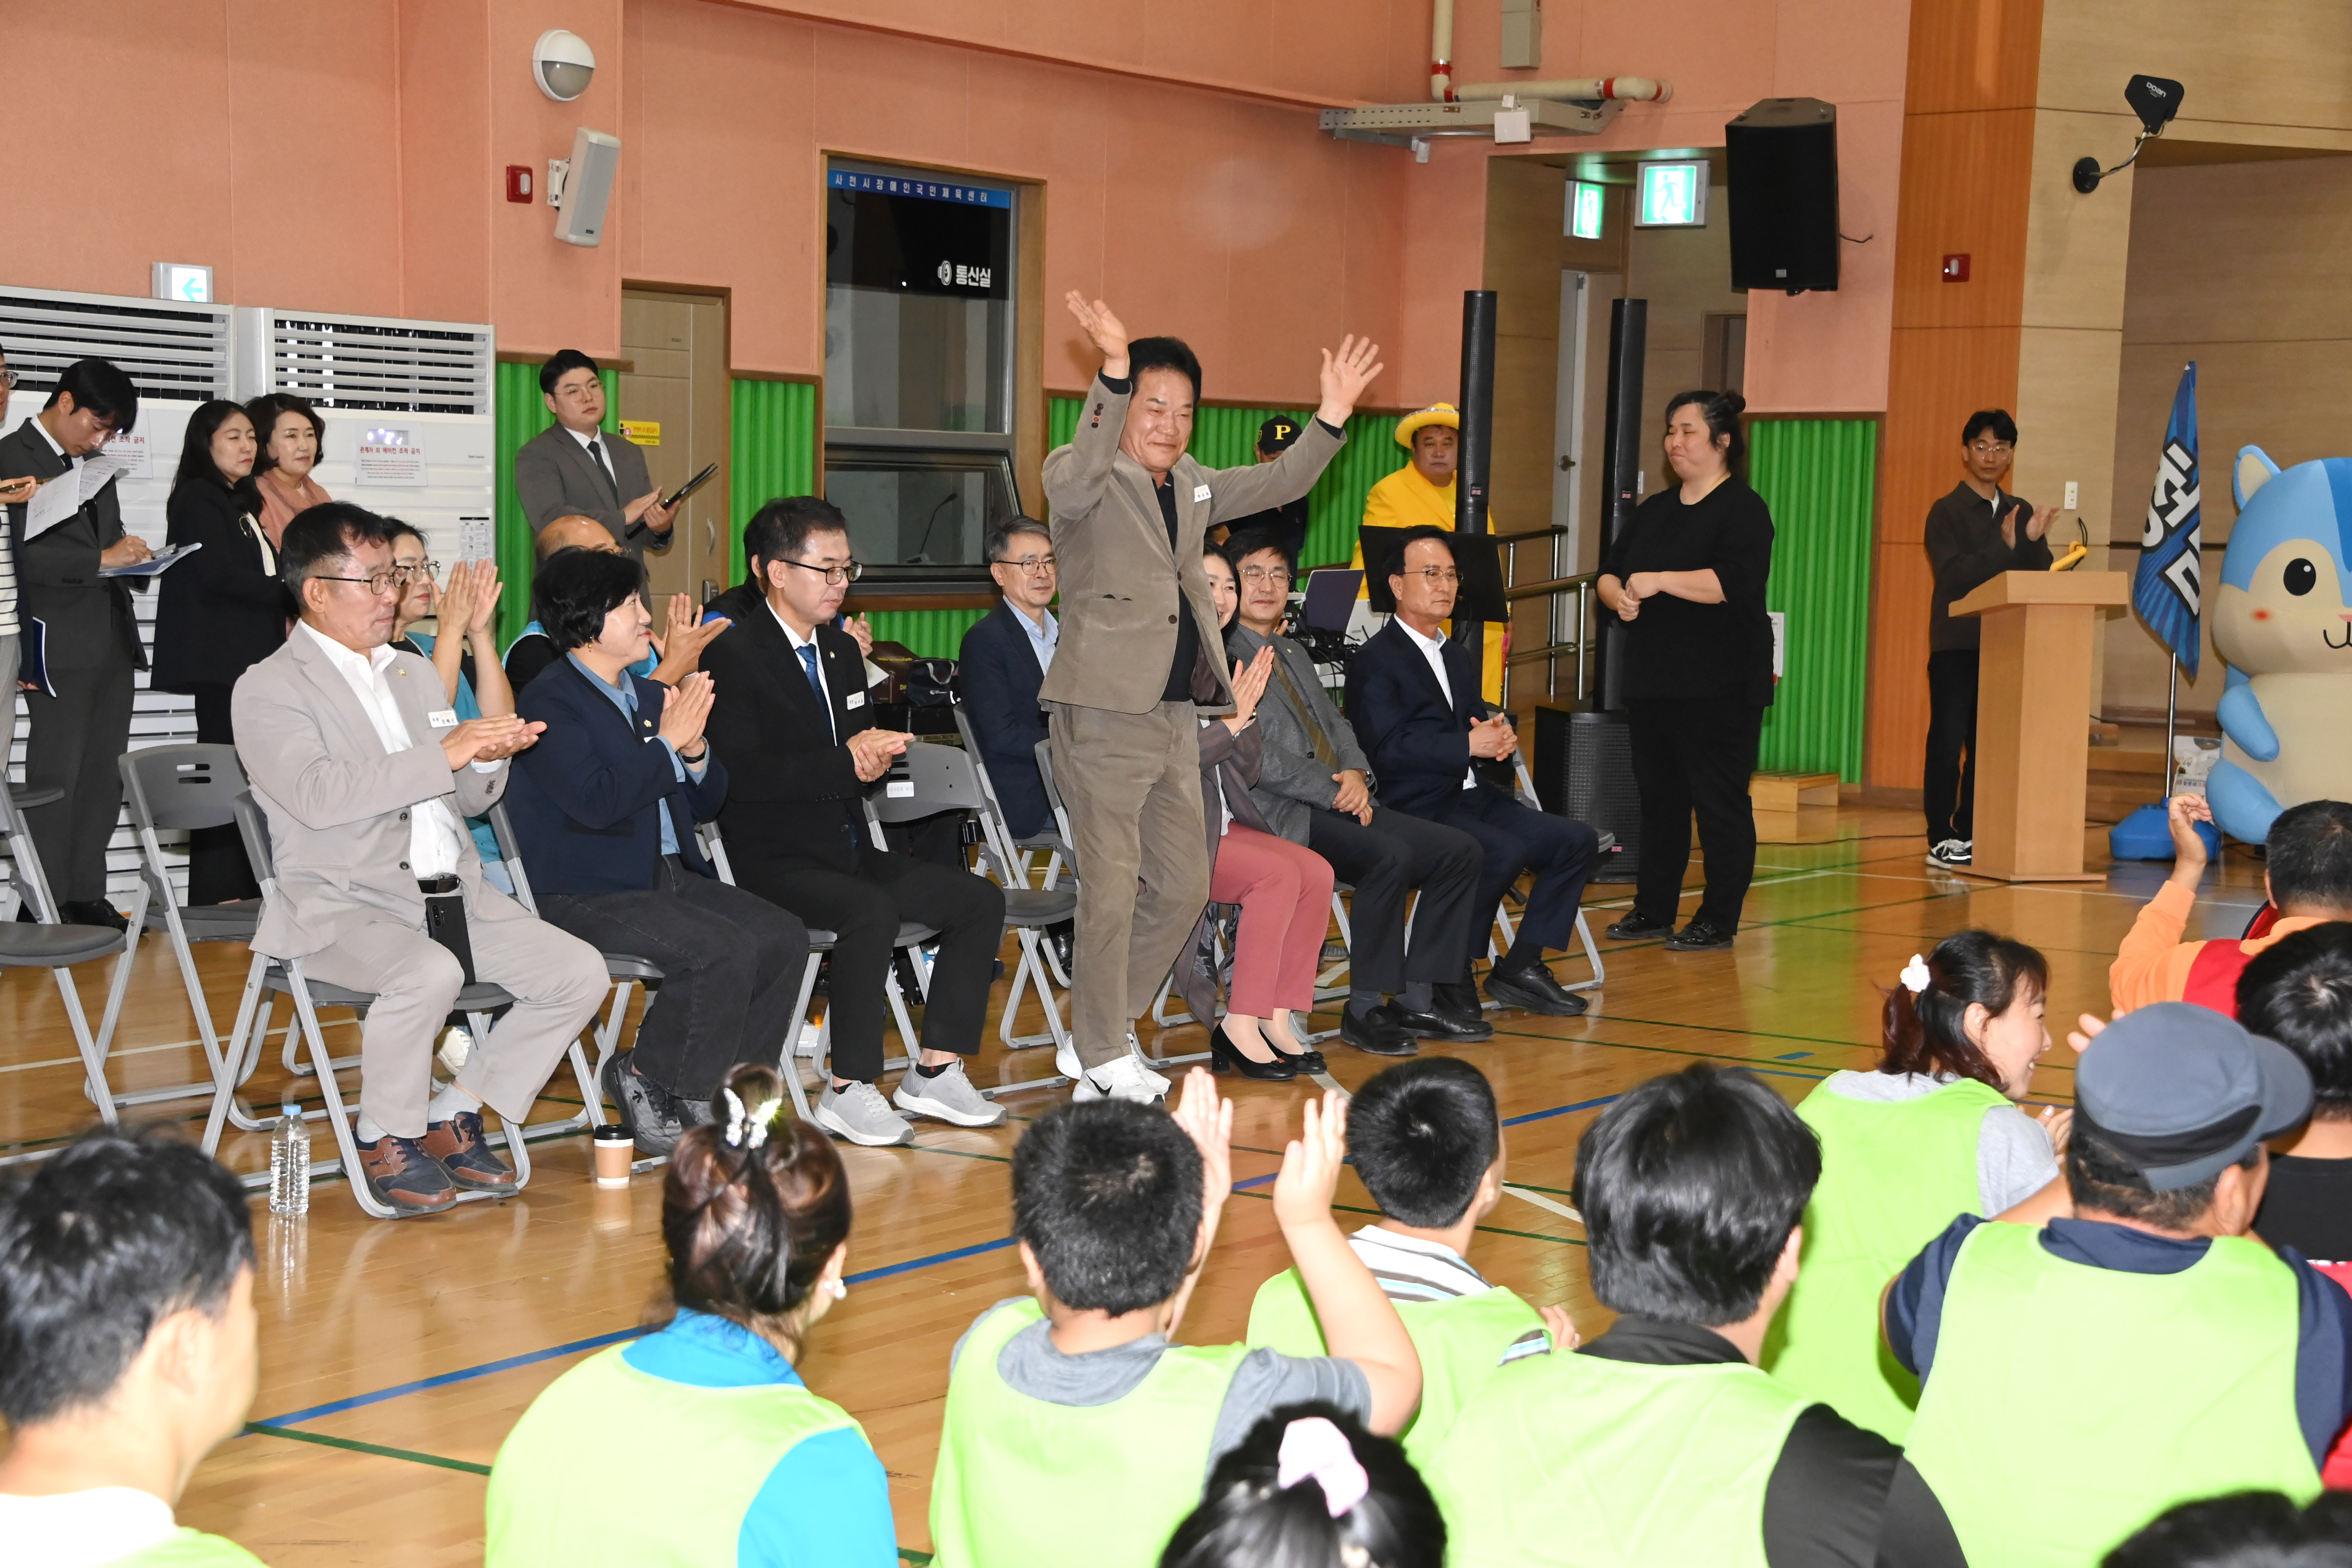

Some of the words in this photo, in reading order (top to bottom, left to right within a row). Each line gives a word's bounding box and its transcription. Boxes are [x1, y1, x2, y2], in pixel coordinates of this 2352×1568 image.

[836, 174, 987, 203] 사천시장애인국민체육센터
[956, 265, 991, 288] 통신실
[1274, 425, 1291, 440] P
